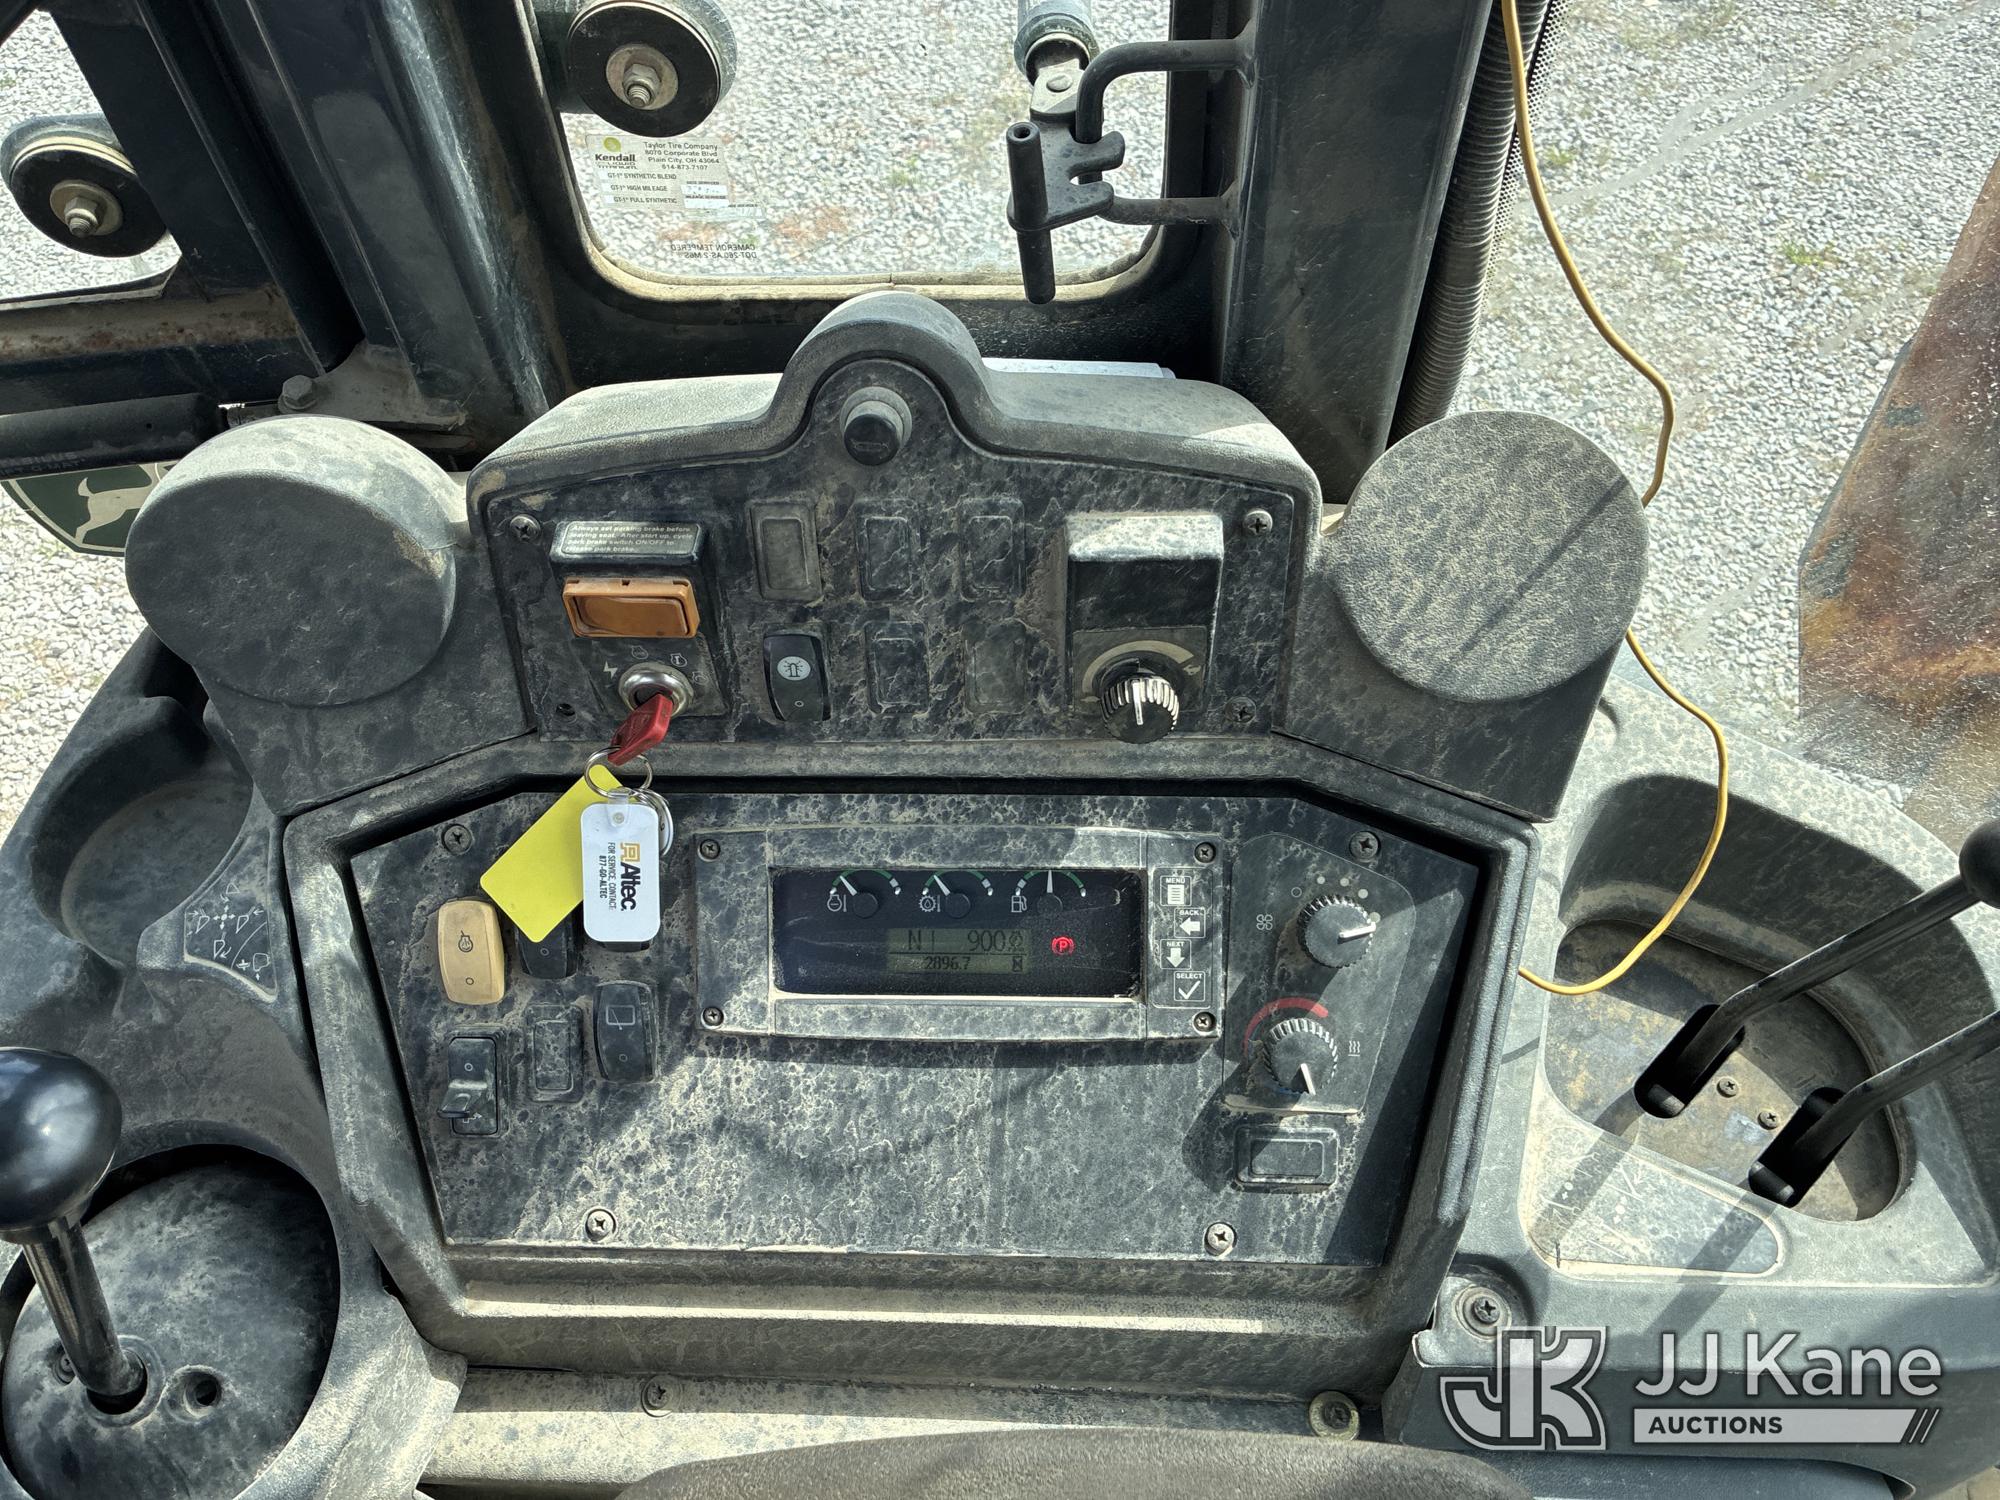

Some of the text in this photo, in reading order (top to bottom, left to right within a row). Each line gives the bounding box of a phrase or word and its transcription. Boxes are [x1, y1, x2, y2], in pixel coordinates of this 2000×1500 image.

[643, 141, 718, 151] Taylor Tire Company
[595, 153, 635, 162] Kendall
[607, 842, 616, 854] FOR
[607, 855, 617, 881] SERVICE,
[967, 929, 1006, 952] 900
[924, 955, 971, 970] 2896.7
